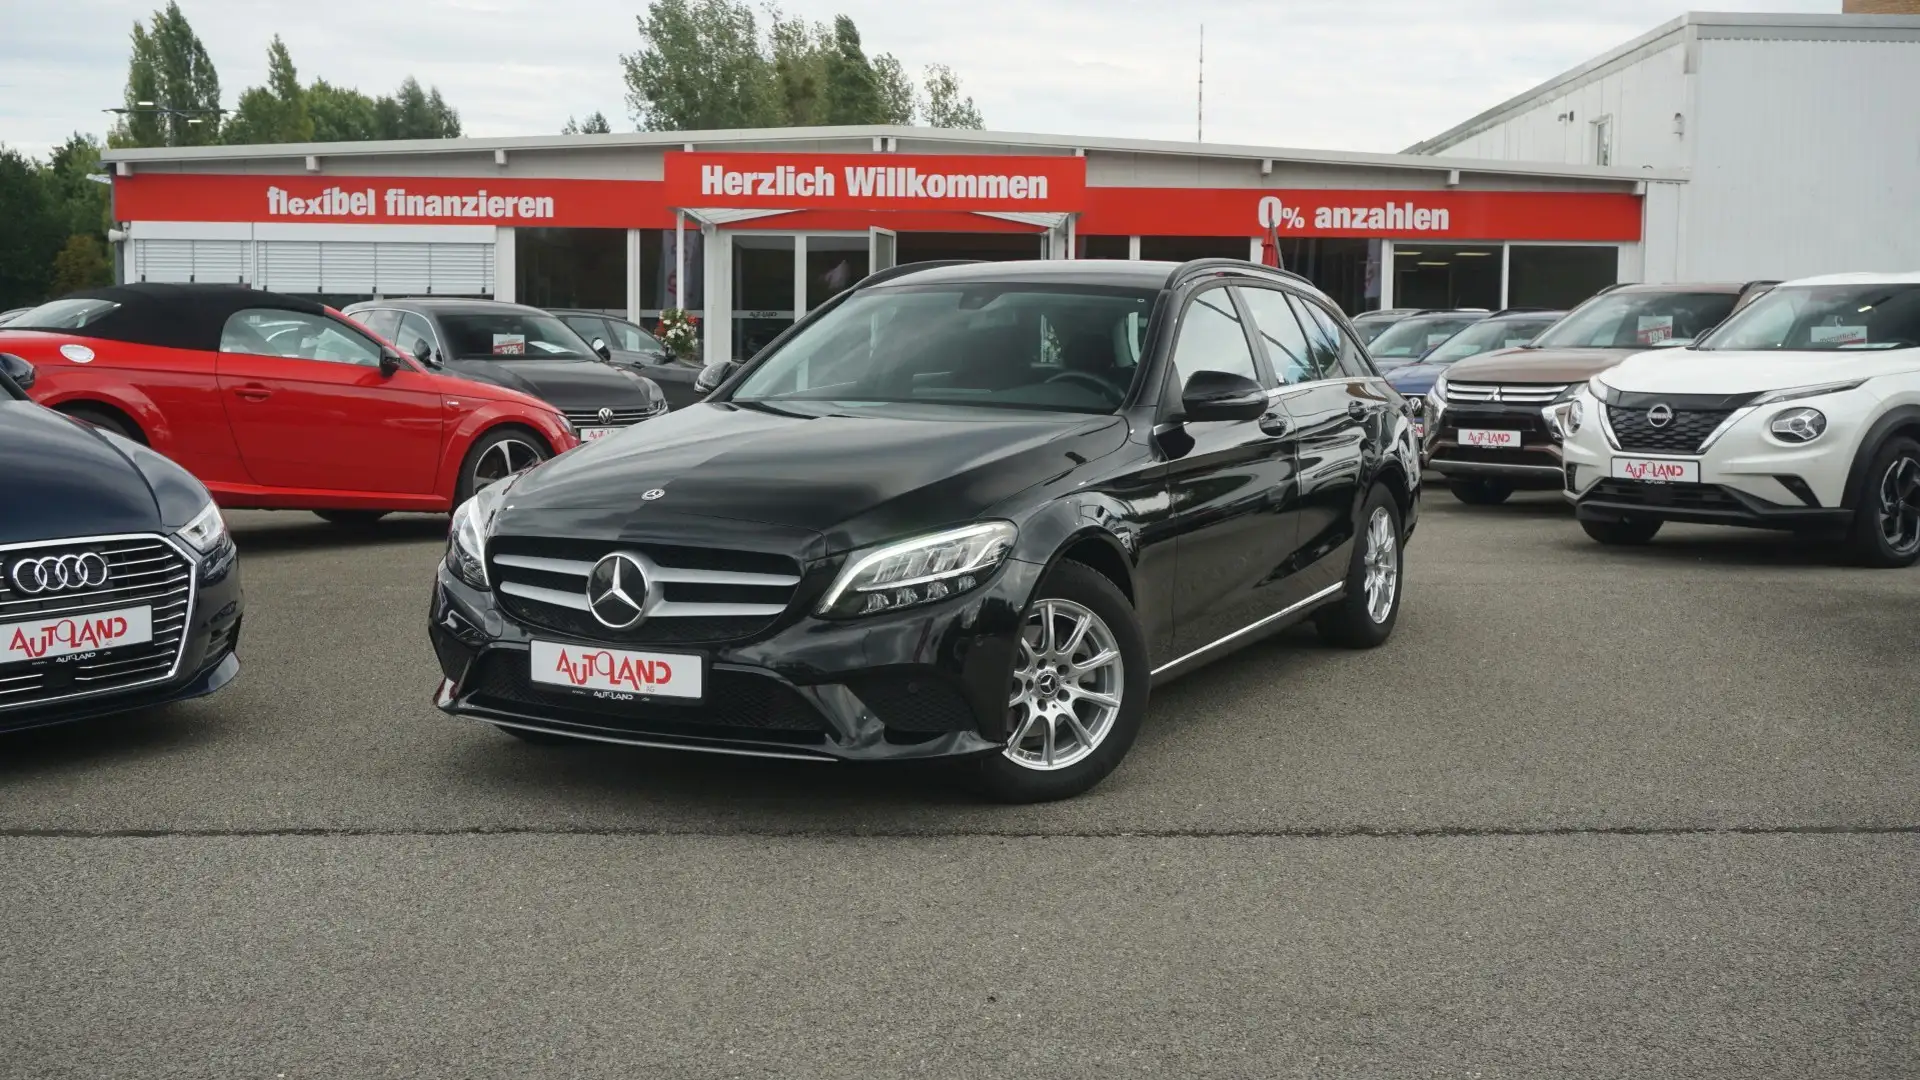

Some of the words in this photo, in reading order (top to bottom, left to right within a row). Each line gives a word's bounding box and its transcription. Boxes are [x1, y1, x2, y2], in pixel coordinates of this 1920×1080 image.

[701, 164, 835, 197] Herzlich
[844, 166, 1048, 200] Willkommen
[267, 186, 376, 216] flexibel
[384, 188, 554, 218] finanzieren
[1258, 195, 1305, 229] 0%
[1314, 202, 1449, 230] anzahlen
[1625, 461, 1684, 480] AUTOLAND
[9, 616, 128, 658] AUTOLAND
[556, 648, 672, 691] AUTOLAND
